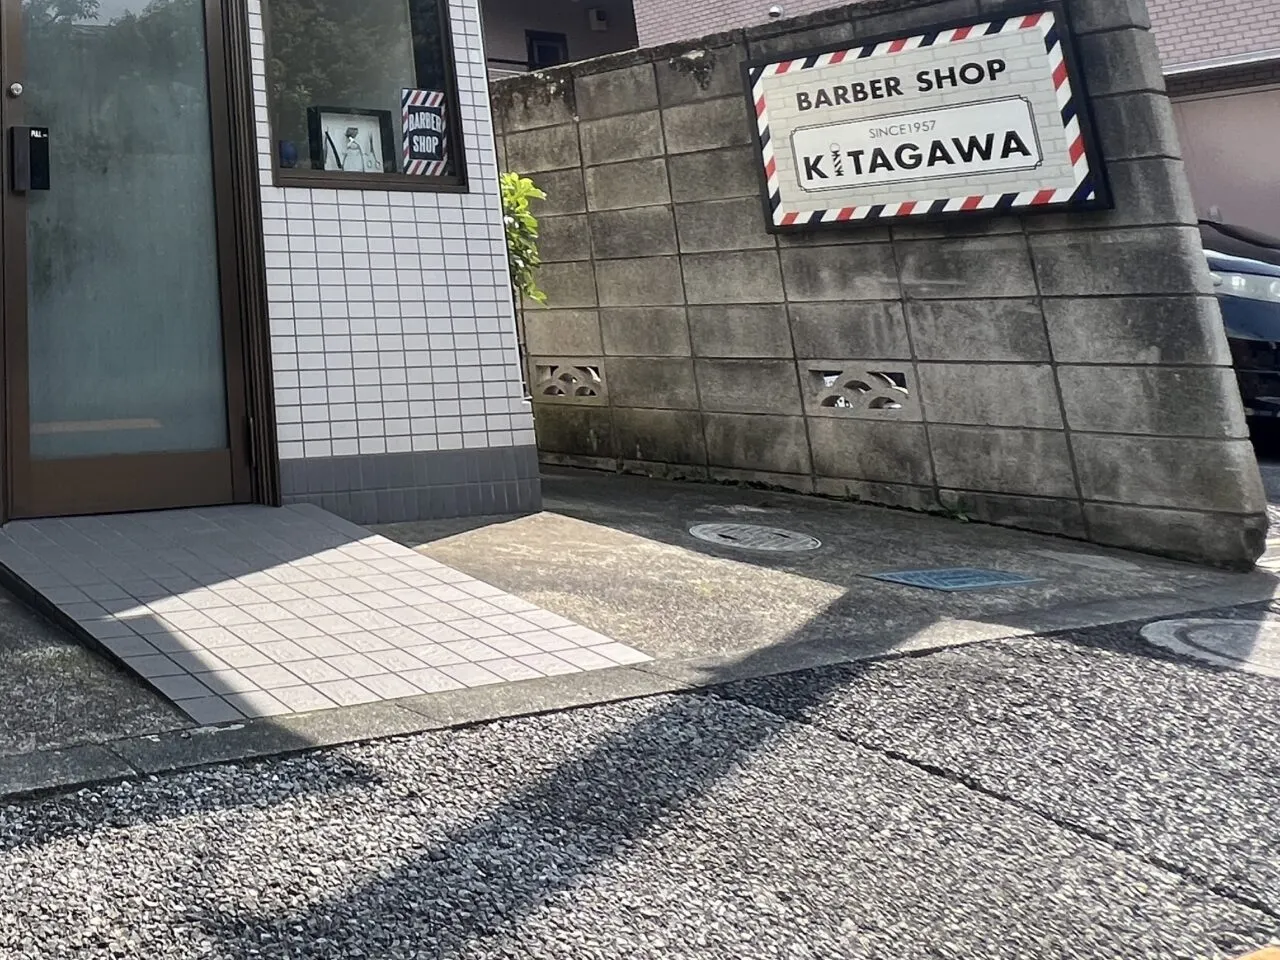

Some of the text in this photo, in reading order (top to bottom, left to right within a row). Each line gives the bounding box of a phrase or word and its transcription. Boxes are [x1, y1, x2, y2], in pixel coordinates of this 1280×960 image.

[796, 58, 1006, 111] BARBER SHOP
[409, 112, 441, 133] BARBER
[868, 120, 936, 139] SINCE1957
[413, 135, 438, 153] SHOP
